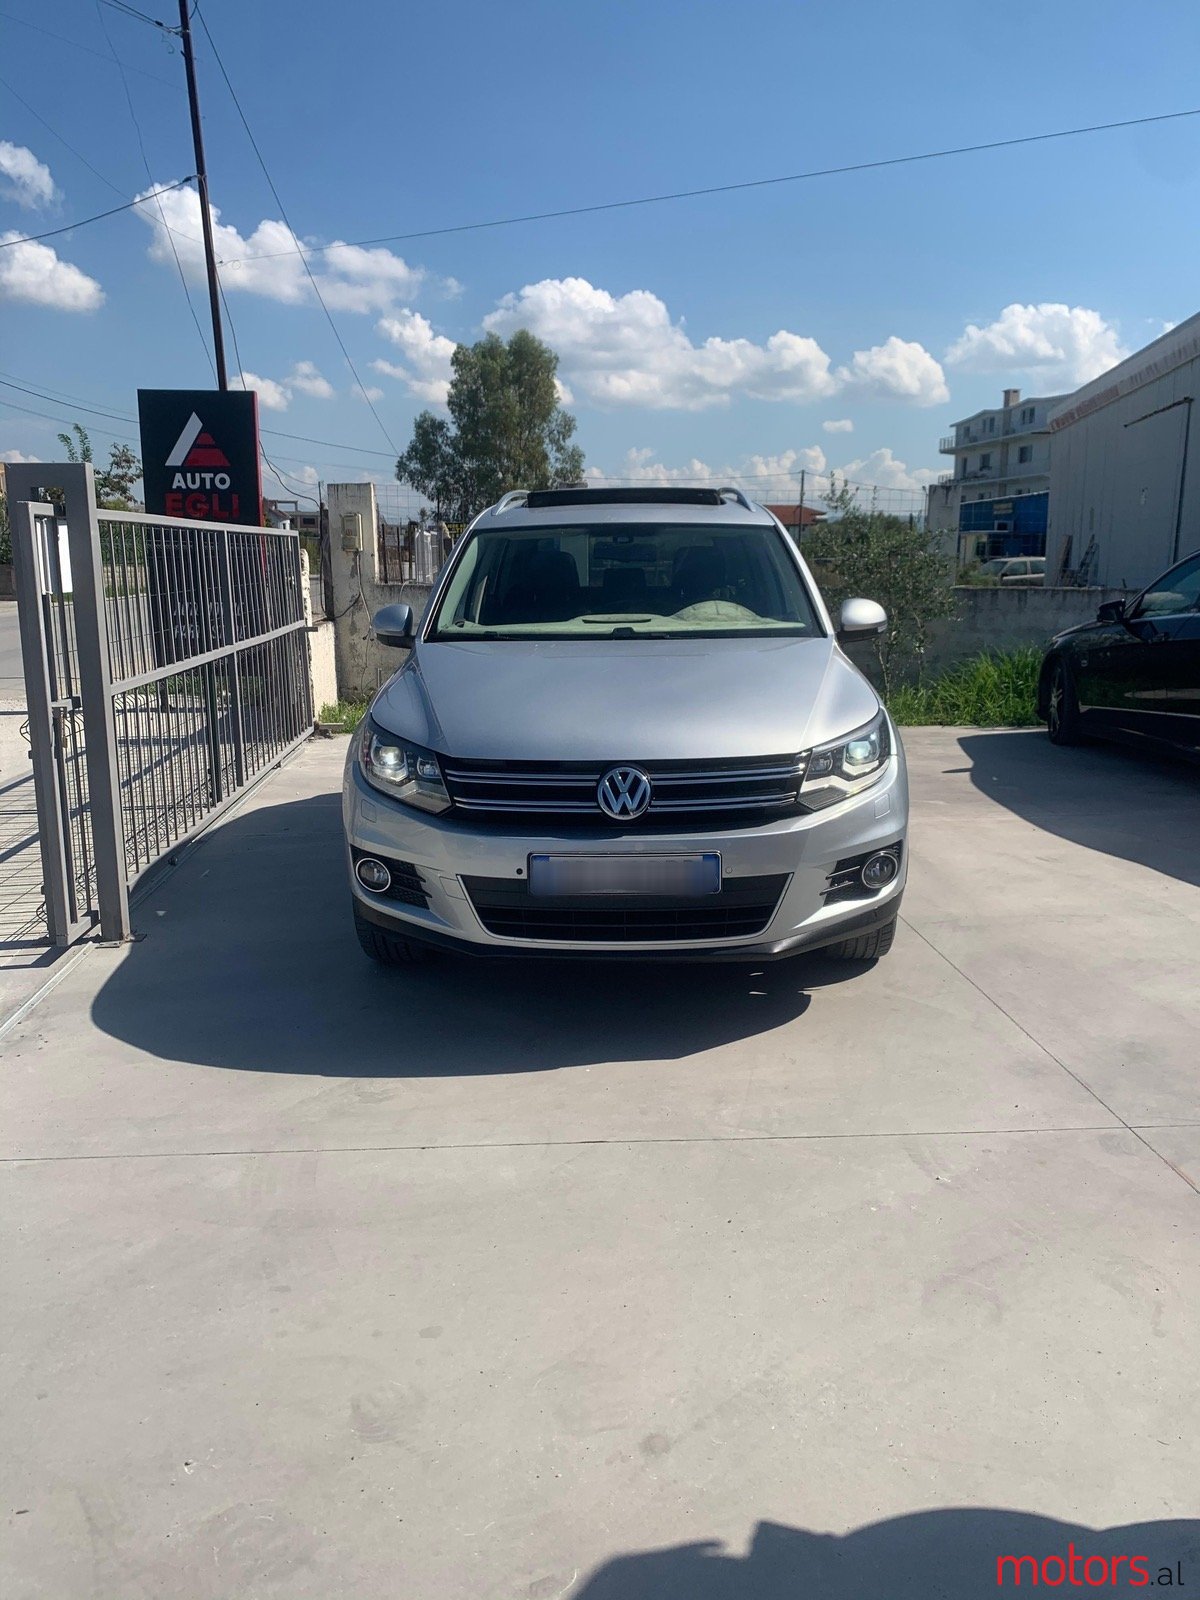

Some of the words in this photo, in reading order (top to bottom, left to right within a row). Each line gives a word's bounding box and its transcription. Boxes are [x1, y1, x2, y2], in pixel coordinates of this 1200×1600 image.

[171, 472, 231, 490] AUTO
[165, 492, 240, 519] EGLI
[599, 768, 649, 818] VW
